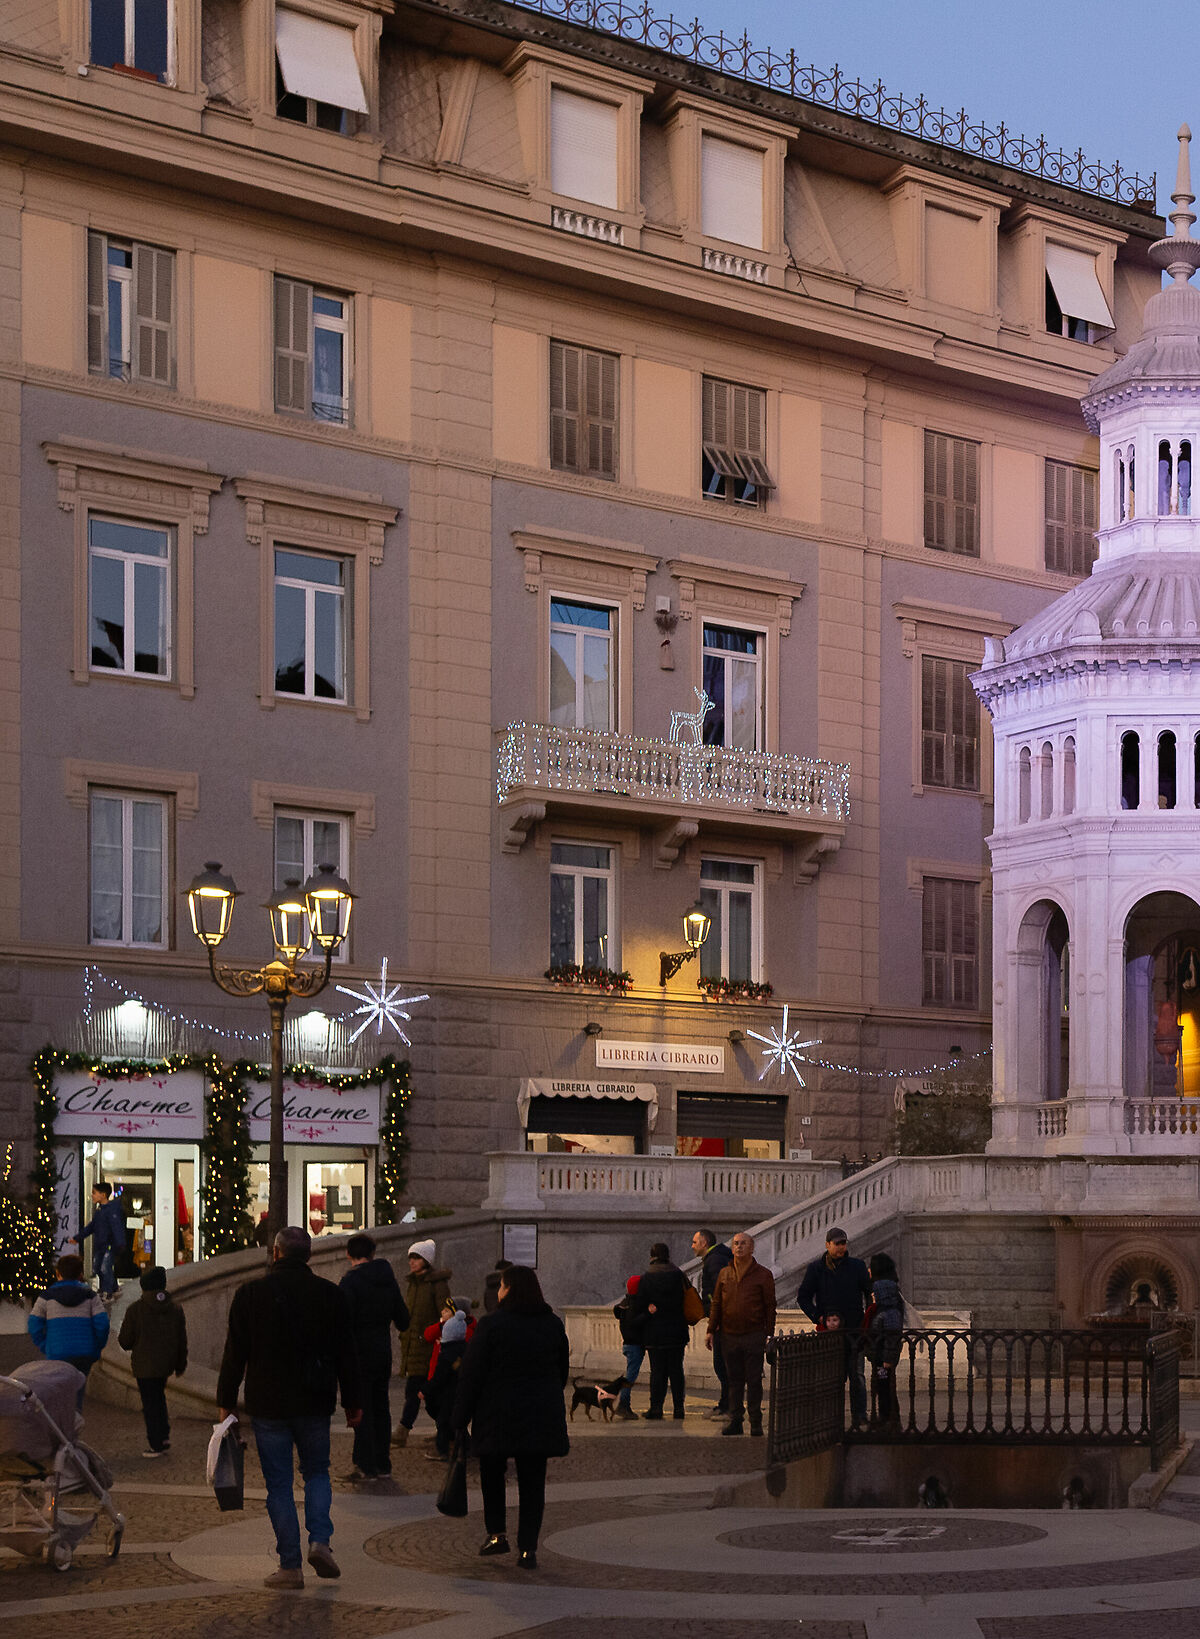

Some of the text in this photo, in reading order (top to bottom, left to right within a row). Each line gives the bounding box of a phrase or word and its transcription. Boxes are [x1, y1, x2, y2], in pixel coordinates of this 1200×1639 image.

[602, 1048, 719, 1065] LIBRERIA CIBRARIO
[552, 1083, 636, 1093] LIBRERIA CIBRARIO
[64, 1086, 193, 1114] Charme
